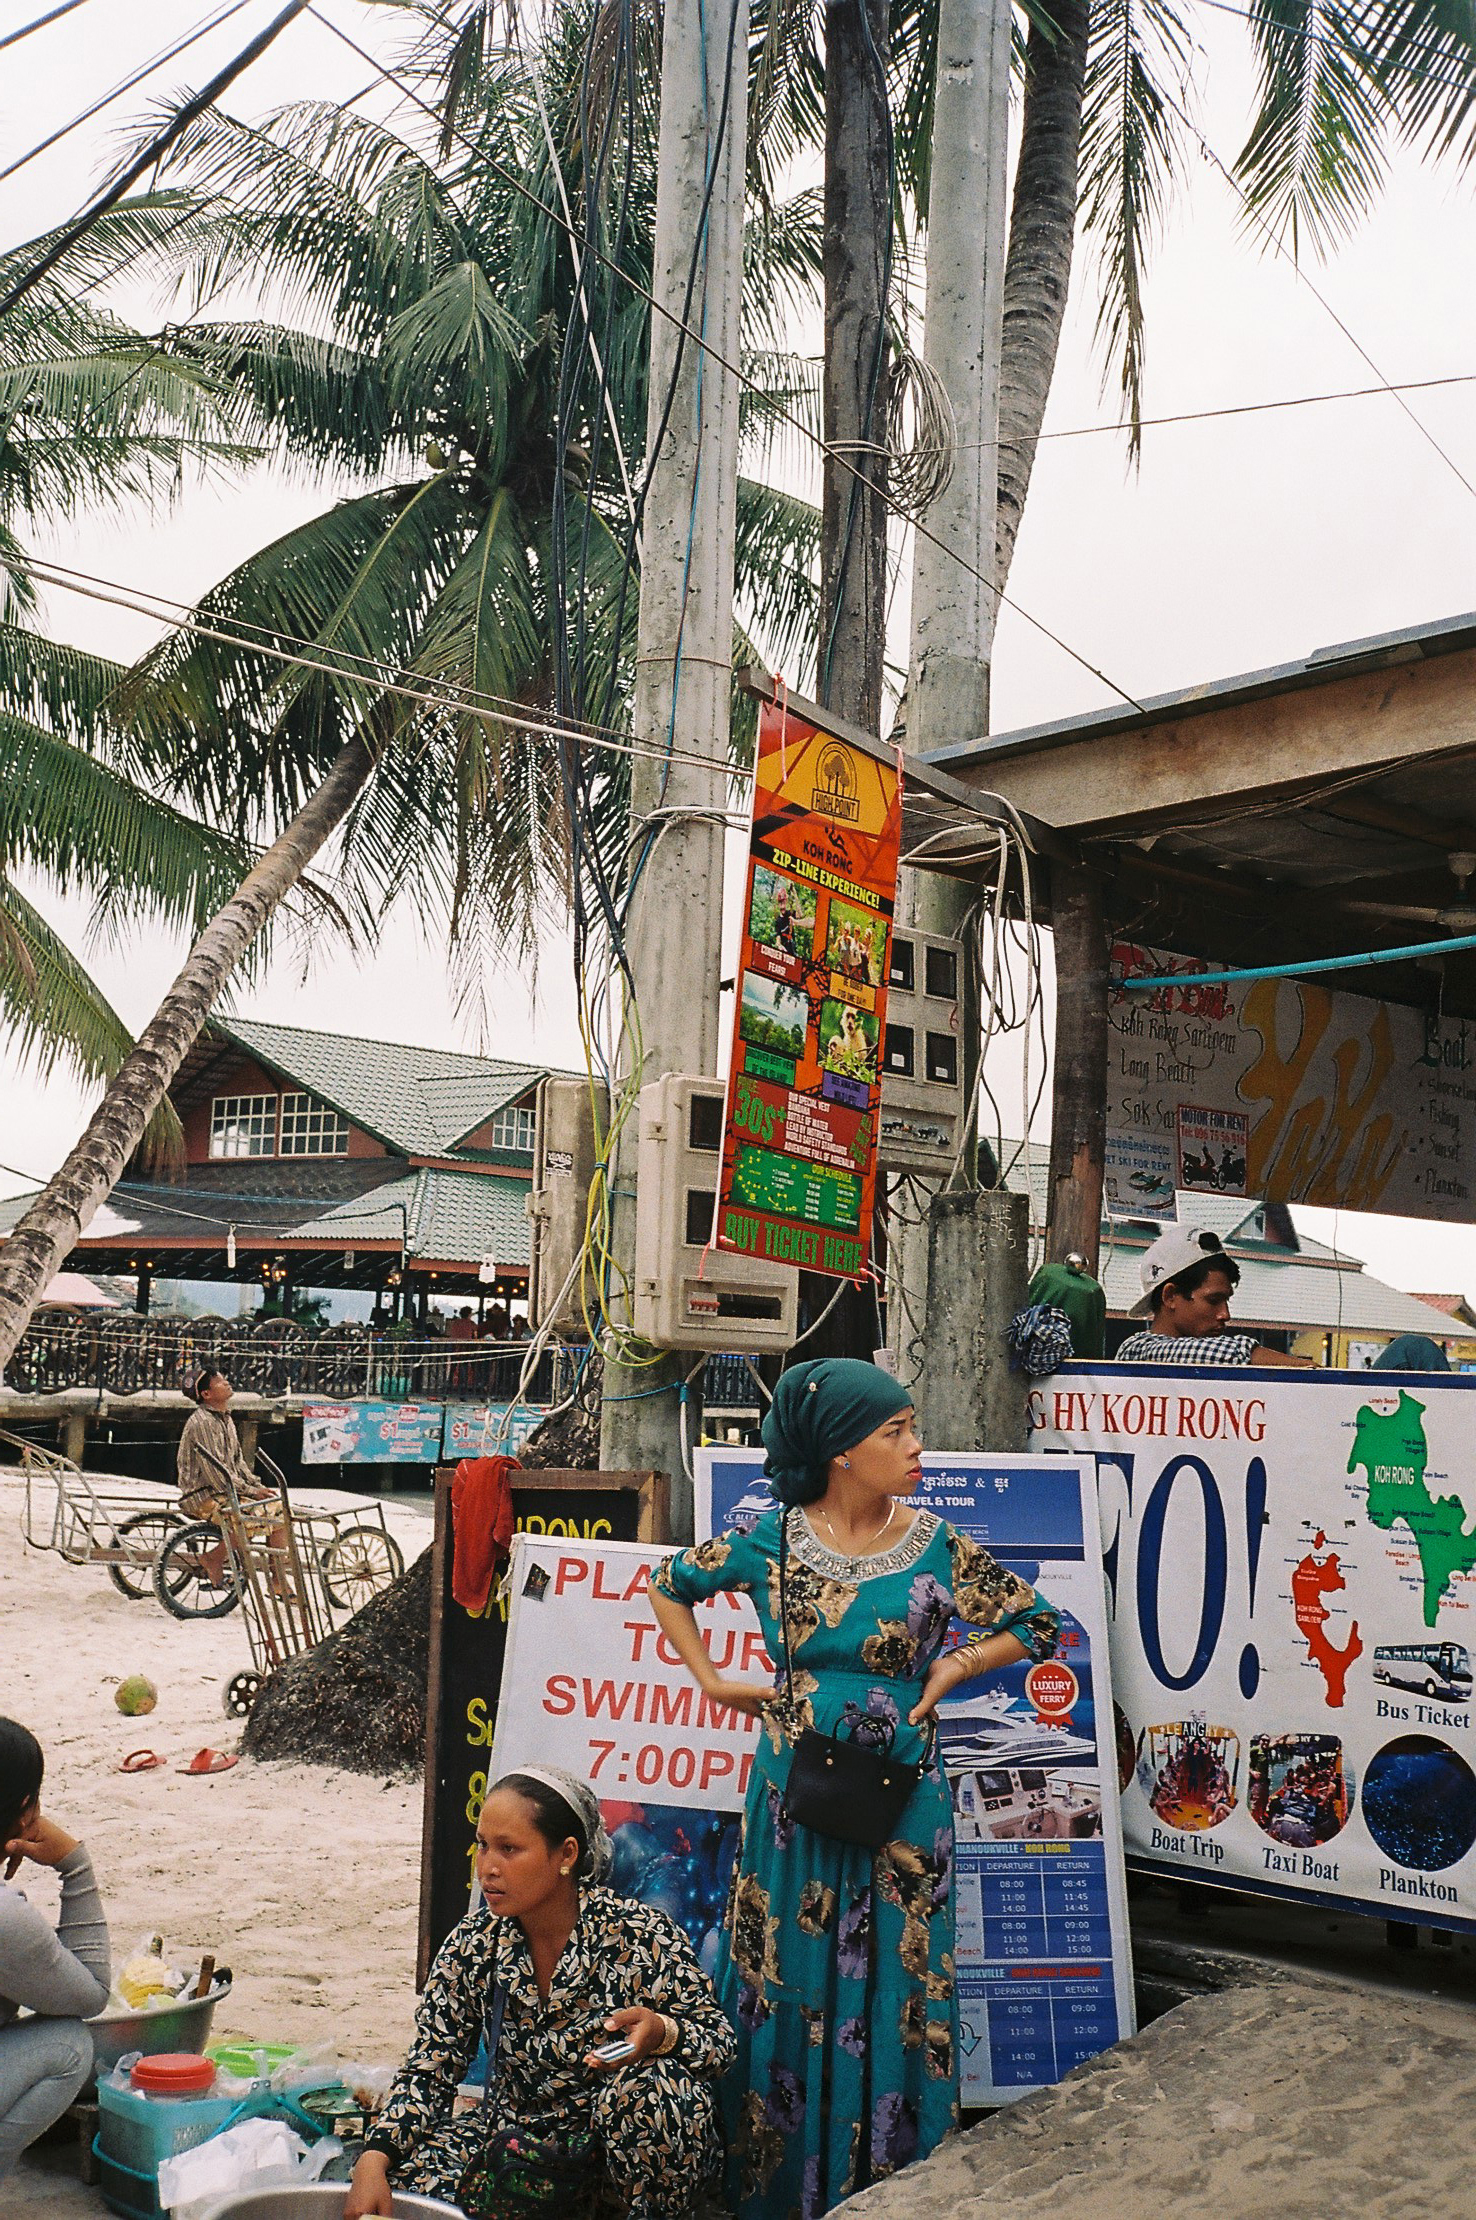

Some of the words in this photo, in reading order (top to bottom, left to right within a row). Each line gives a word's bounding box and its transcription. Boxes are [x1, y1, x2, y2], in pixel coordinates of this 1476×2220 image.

[815, 792, 834, 813] HIGH
[834, 797, 857, 818] POINT
[803, 840, 824, 861] KOH
[825, 849, 853, 875] RONG
[772, 847, 819, 882] ZIP-LINE
[819, 870, 880, 909] EXPERIENCE!
[1181, 1109, 1208, 1126] MOTOR
[1209, 1112, 1225, 1129] FOR
[1226, 1115, 1246, 1132] RENT
[1133, 1159, 1150, 1170] FOR
[1151, 1160, 1172, 1172] RENT
[725, 1212, 760, 1251] BUY
[764, 1221, 820, 1265] TICKET
[823, 1236, 863, 1275] HERE
[1053, 1391, 1097, 1432] HY
[1102, 1393, 1170, 1437] KOH
[1176, 1397, 1267, 1442] RONG
[1374, 1465, 1391, 1484] KOH
[1391, 1466, 1415, 1486] RONG
[892, 1495, 934, 1507] TRAVEL
[946, 1496, 976, 1507] TOUR
[1032, 1680, 1072, 1691] LUXURY
[1039, 1695, 1066, 1703] FERRY
[1376, 1699, 1409, 1721] Bus
[1414, 1704, 1471, 1729] Ticket
[1150, 1828, 1186, 1854] Boat
[1189, 1834, 1224, 1864] Trip
[1056, 1861, 1090, 1869] RETURN
[1262, 1847, 1297, 1875] Taxi
[1302, 1855, 1340, 1881] Boat
[999, 1880, 1025, 1888] 08:00
[1062, 1879, 1087, 1888] 08:45
[1378, 1868, 1459, 1903] Plankton
[1001, 1893, 1026, 1901] 11:00
[1064, 1892, 1089, 1901] 11:45
[1002, 1904, 1027, 1912] 14:00
[1064, 1904, 1089, 1912] 14:45
[1001, 1922, 1027, 1930] 08:00
[1064, 1921, 1090, 1929] 09:00
[1003, 1935, 1027, 1943] 11:00
[1066, 1934, 1091, 1942] 12:00
[1004, 1946, 1029, 1955] 14:00
[1067, 1945, 1092, 1954] 15:00
[994, 1987, 1043, 1995] DEPARTURE
[1065, 1985, 1099, 1994] RETURN
[1008, 2006, 1033, 2014] 08:00
[1071, 2004, 1097, 2013] 09:00
[1010, 2027, 1035, 2036] 11:00
[1074, 2026, 1099, 2034] 12:00
[1011, 2053, 1036, 2061] 14:00
[1016, 2071, 1033, 2079] N/A
